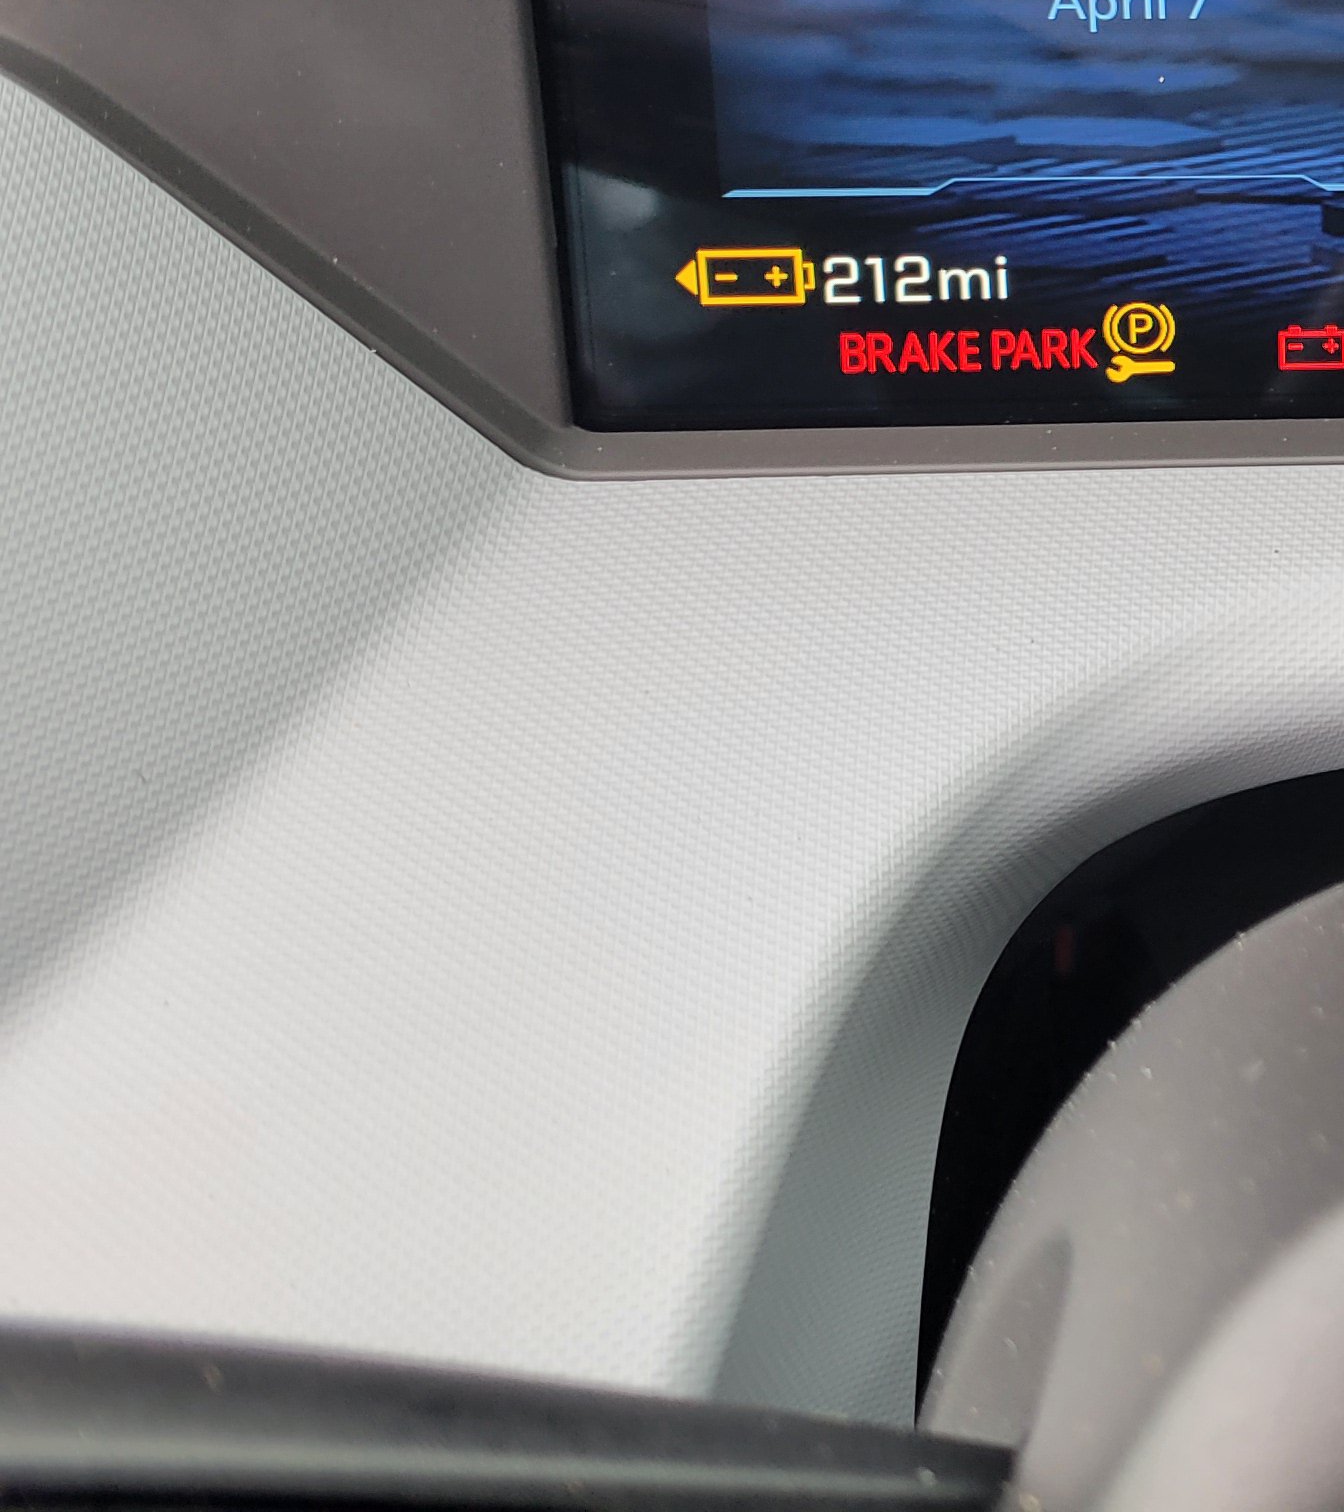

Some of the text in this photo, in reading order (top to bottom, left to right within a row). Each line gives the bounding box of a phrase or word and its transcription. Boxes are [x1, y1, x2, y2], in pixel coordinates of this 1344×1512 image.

[823, 255, 1008, 304] 212mi
[839, 328, 1099, 374] BRAKE PARK
